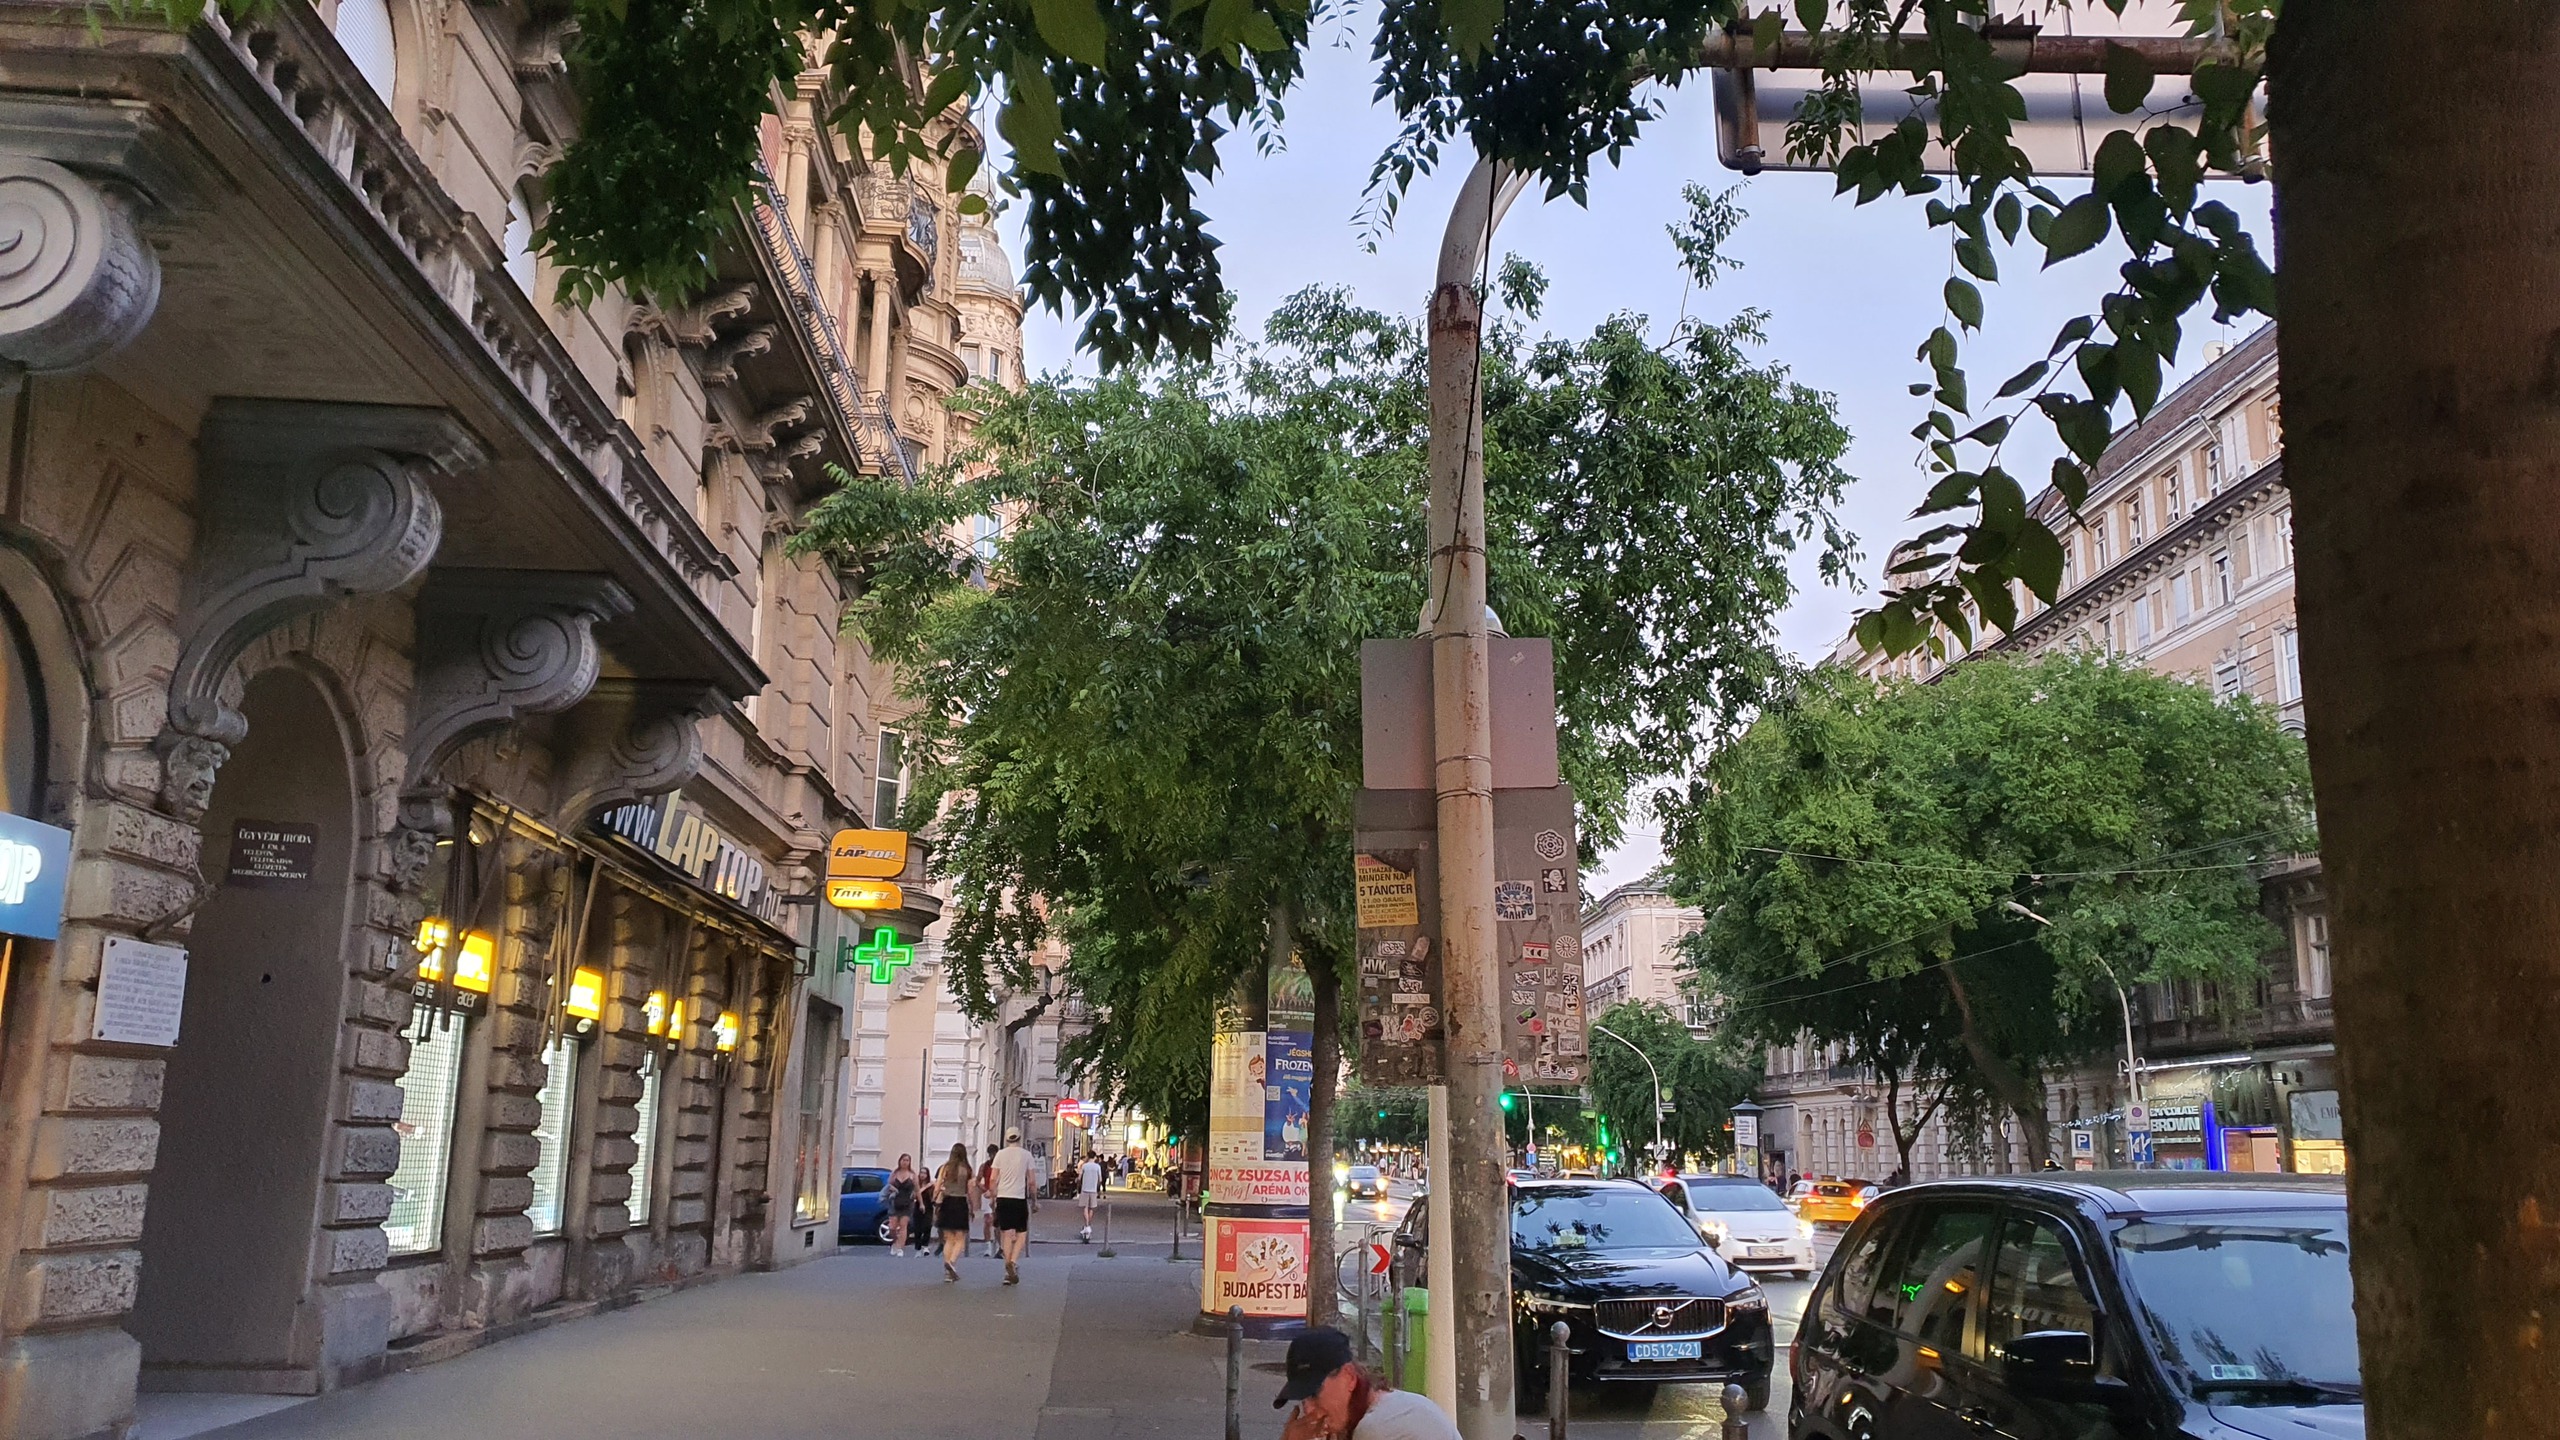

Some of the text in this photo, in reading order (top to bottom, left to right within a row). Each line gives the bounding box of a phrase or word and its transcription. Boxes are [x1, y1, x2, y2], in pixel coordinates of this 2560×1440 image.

[239, 828, 312, 844] ÜGYVÉDI IRODA
[1359, 873, 1391, 882] MINDEN
[1360, 881, 1413, 896] 5 TÁNCTÉR
[1363, 959, 1386, 974] HVK
[1563, 975, 1578, 984] 52
[457, 991, 478, 1008] acer
[2150, 1117, 2200, 1132] BROWN
[2077, 1134, 2088, 1148] P
[1237, 1170, 1292, 1182] ZSUZSA
[1253, 1183, 1291, 1196] ARÉNA
[1223, 1281, 1290, 1300] BUDAPEST
